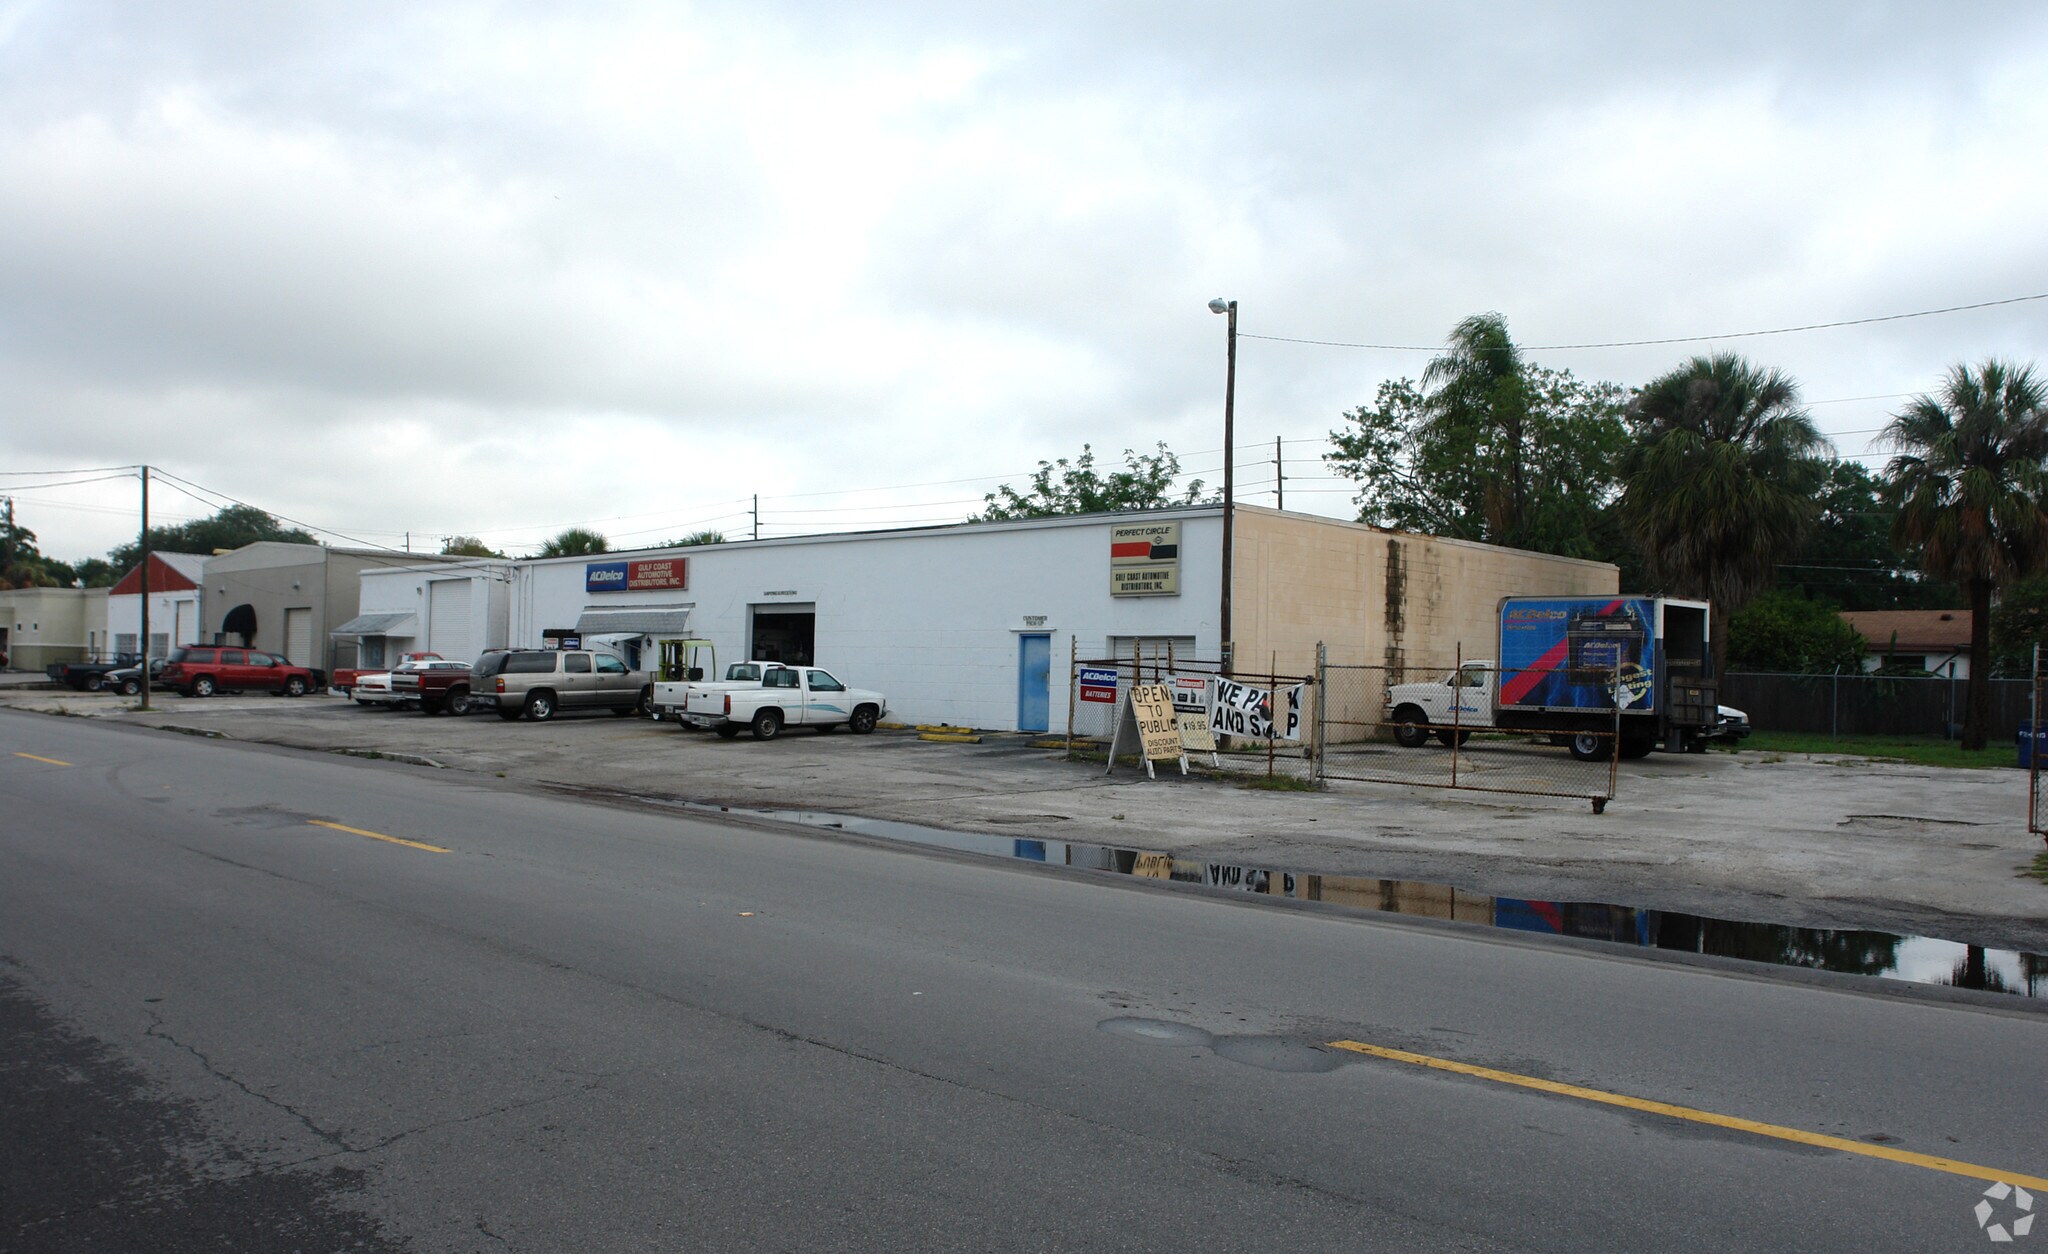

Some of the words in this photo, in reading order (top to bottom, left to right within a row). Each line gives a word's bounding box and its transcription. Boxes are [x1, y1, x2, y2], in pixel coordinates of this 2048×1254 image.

[1116, 529, 1145, 537] PERFECT
[1146, 527, 1170, 535] CIRCLE
[638, 563, 652, 571] GULF
[653, 562, 672, 570] COAST
[589, 570, 624, 582] ACDelco
[637, 570, 673, 579] AUTOMOTIVE
[1127, 572, 1141, 580] COAST
[1507, 608, 1568, 619] ACDelco
[1082, 671, 1116, 682] ACDelco
[1607, 680, 1652, 694] Lting
[1084, 689, 1112, 699] BATTERIES
[1133, 685, 1170, 704] OPEN
[1217, 679, 1243, 707] WE
[1146, 704, 1163, 718] TO
[1212, 706, 1245, 734] AND
[1139, 718, 1179, 736] PUBLIC
[1147, 737, 1178, 748] DISCOUNT
[1147, 747, 1162, 756] AUTO
[1163, 745, 1182, 755] PARTS
